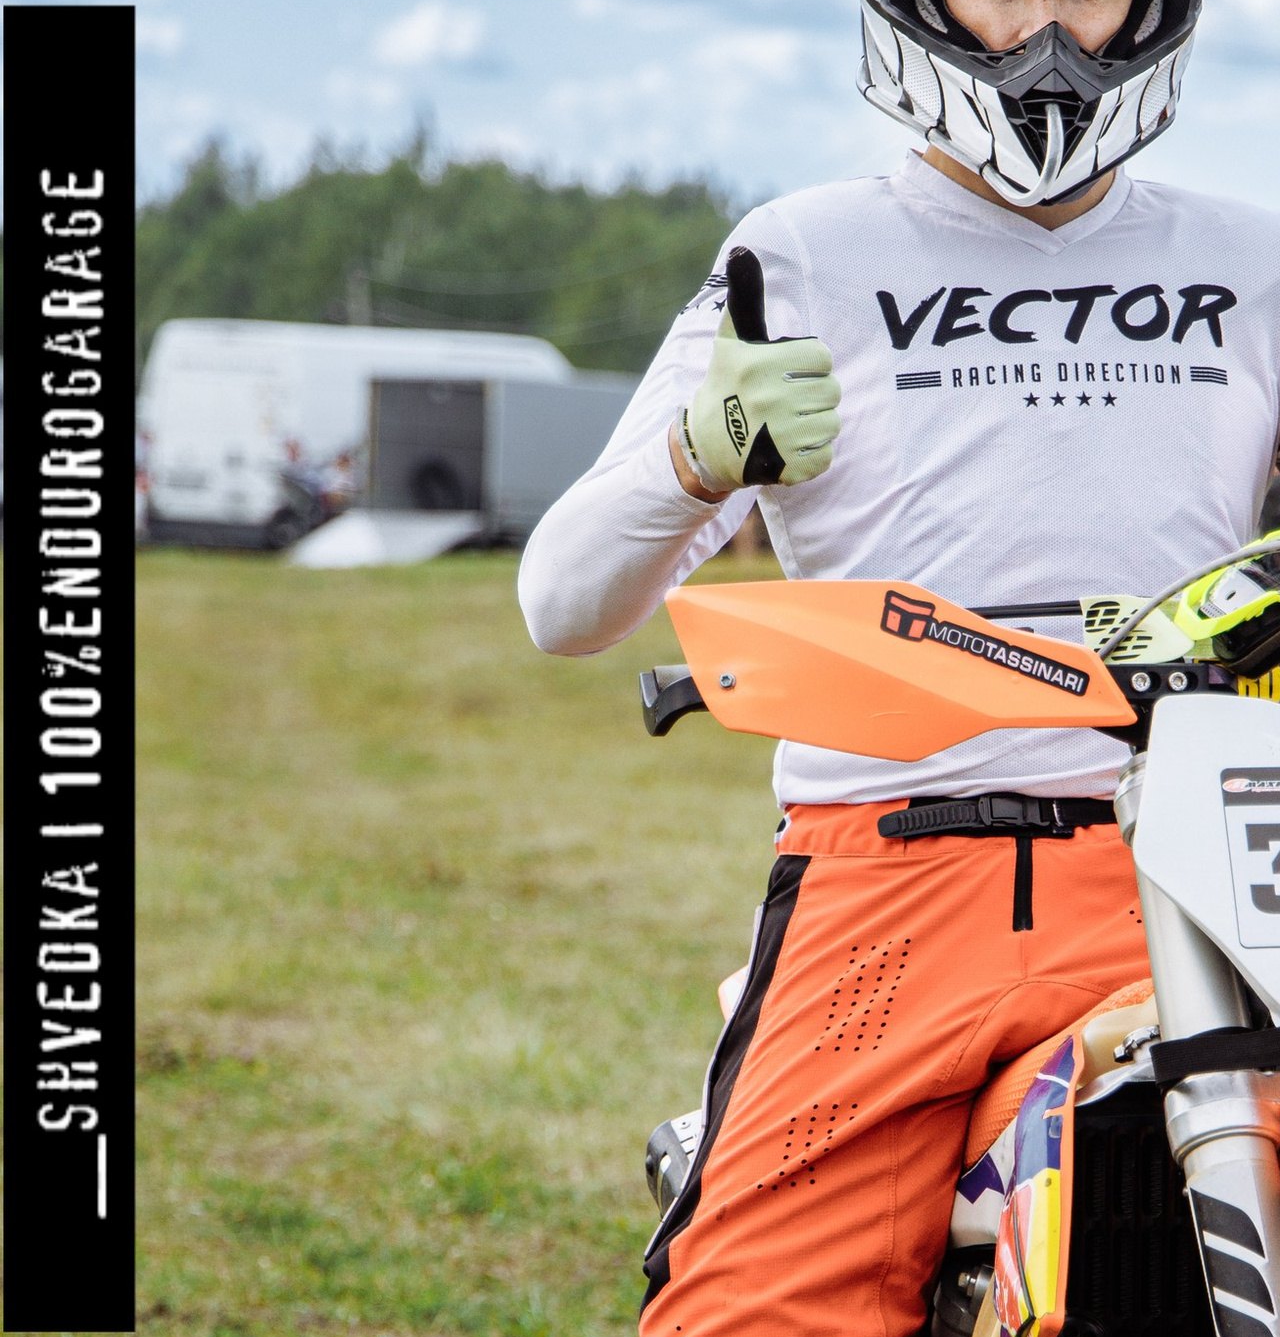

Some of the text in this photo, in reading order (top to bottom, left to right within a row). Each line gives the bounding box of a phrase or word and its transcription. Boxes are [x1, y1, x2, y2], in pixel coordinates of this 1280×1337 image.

[875, 283, 1238, 351] VECTOR
[952, 362, 1181, 388] RACING DIRECTION
[727, 403, 747, 450] 100%
[928, 622, 1084, 693] MOTOTASSINARI
